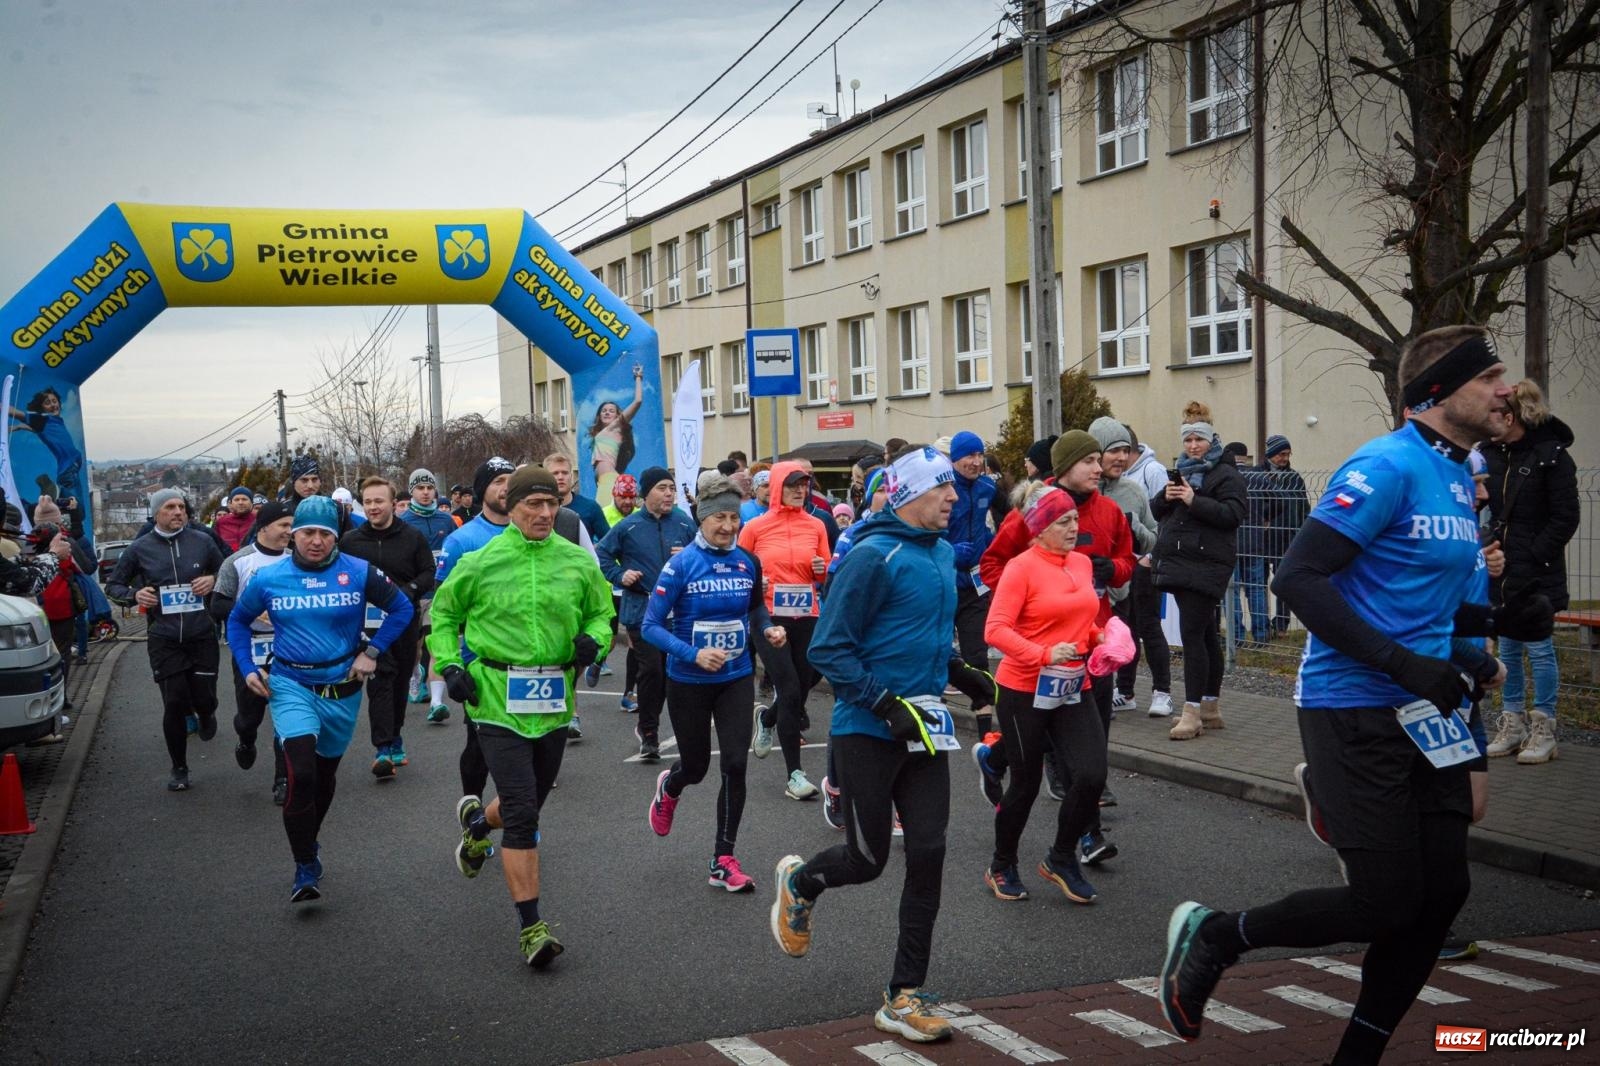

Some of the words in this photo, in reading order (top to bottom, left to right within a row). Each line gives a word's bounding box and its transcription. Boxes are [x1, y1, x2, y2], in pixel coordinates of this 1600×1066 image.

[283, 223, 389, 241] Gmina
[257, 244, 418, 264] Pietrowice
[280, 268, 397, 286] Wielkie
[12, 290, 81, 350] Gmina
[73, 241, 130, 294] ludzi
[528, 245, 583, 300] Gmina
[583, 289, 631, 341] ludzi
[43, 267, 151, 369] aktywnych
[513, 267, 611, 358] aktywnych
[169, 592, 196, 605] 196
[271, 591, 361, 611] RUNNERS
[782, 593, 808, 607] 172
[703, 631, 738, 650] 183
[526, 679, 552, 699] 26
[1049, 678, 1080, 697] 108
[1418, 716, 1461, 748] 178
